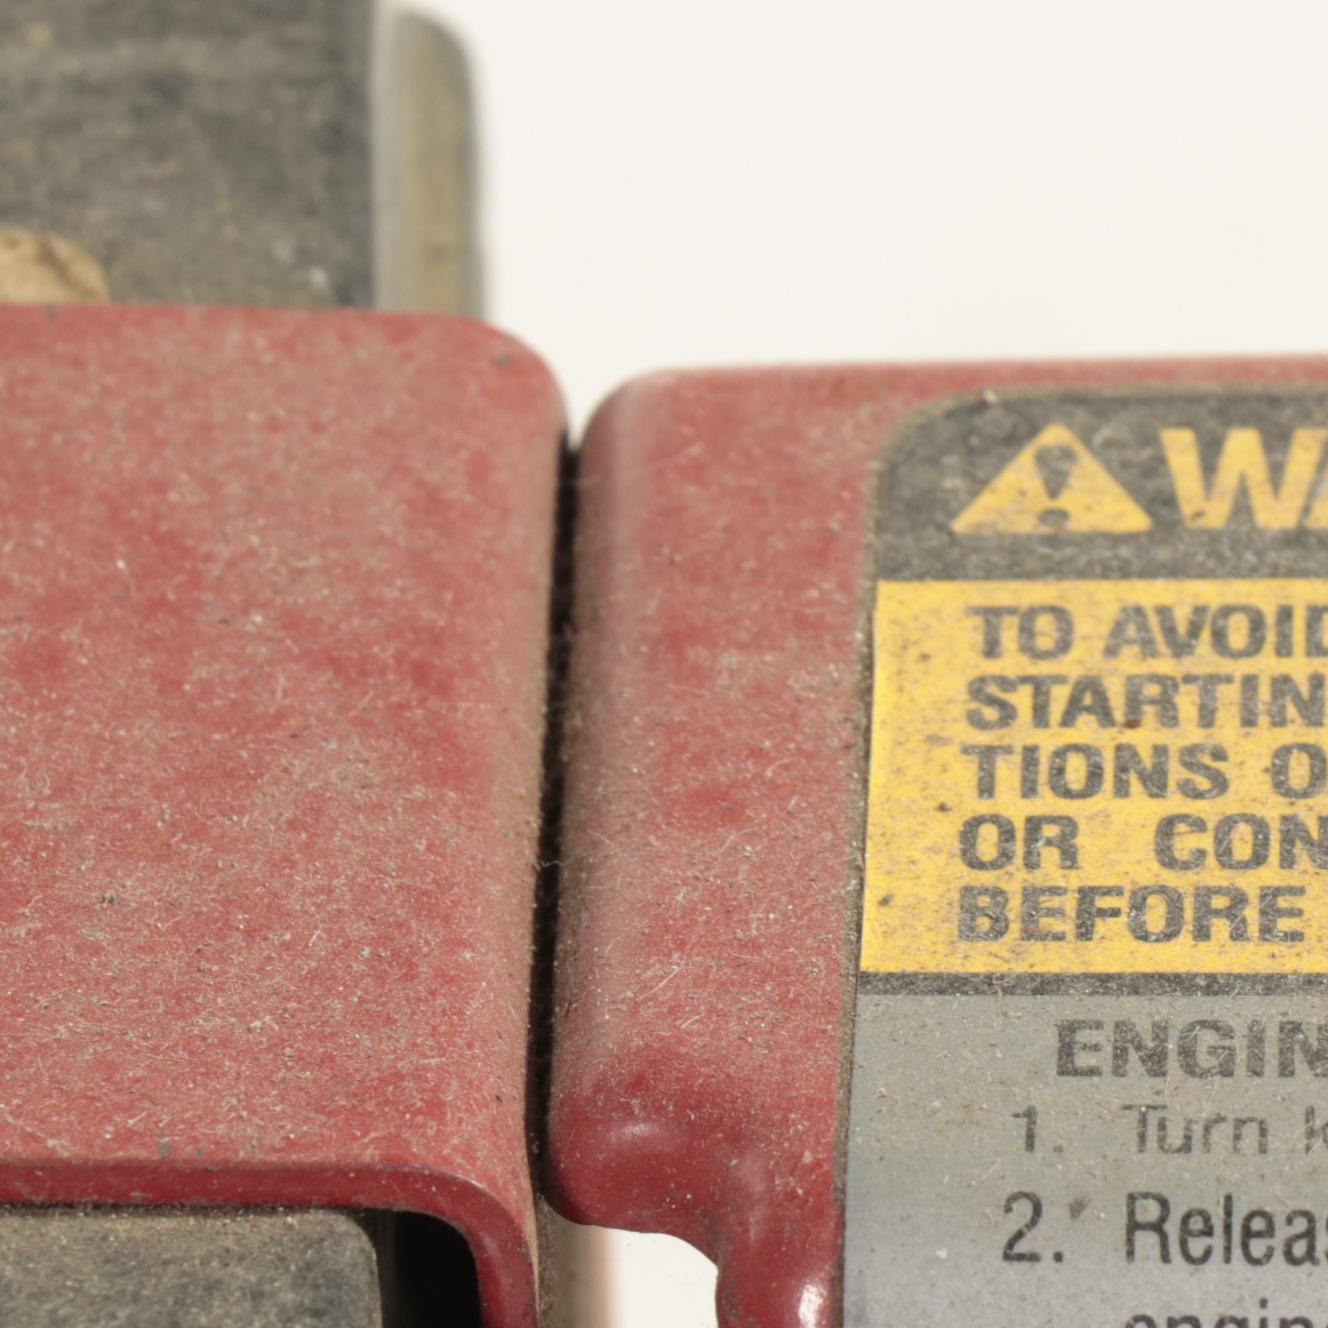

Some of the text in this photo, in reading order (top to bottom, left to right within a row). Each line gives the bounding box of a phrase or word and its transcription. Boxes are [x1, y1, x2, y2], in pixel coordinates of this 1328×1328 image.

[968, 605, 1074, 659] TO
[965, 744, 1229, 799] TIONS
[957, 815, 1079, 869] OR
[957, 886, 1304, 941] BEFORE
[1010, 1109, 1062, 1154] 1.
[1120, 1106, 1267, 1156] Turn
[1002, 1193, 1064, 1263] 2.
